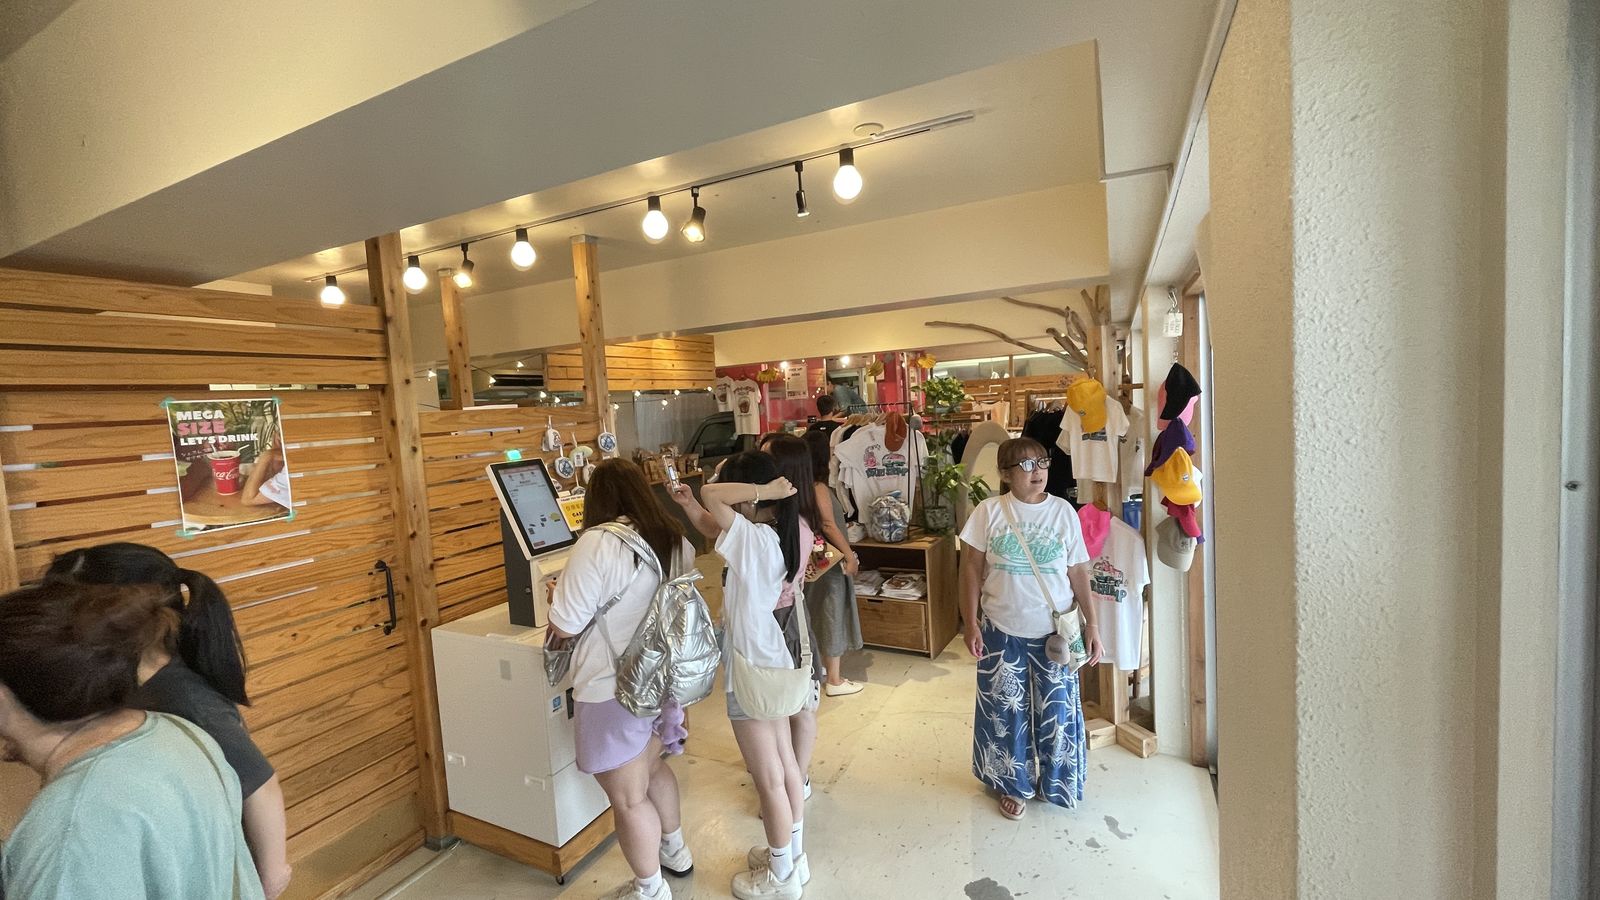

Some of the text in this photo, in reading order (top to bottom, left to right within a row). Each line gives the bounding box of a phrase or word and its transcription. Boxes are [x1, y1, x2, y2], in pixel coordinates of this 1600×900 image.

[176, 410, 225, 420] MEGA
[177, 420, 225, 435] SIZE
[180, 433, 259, 446] LET'S DRINK
